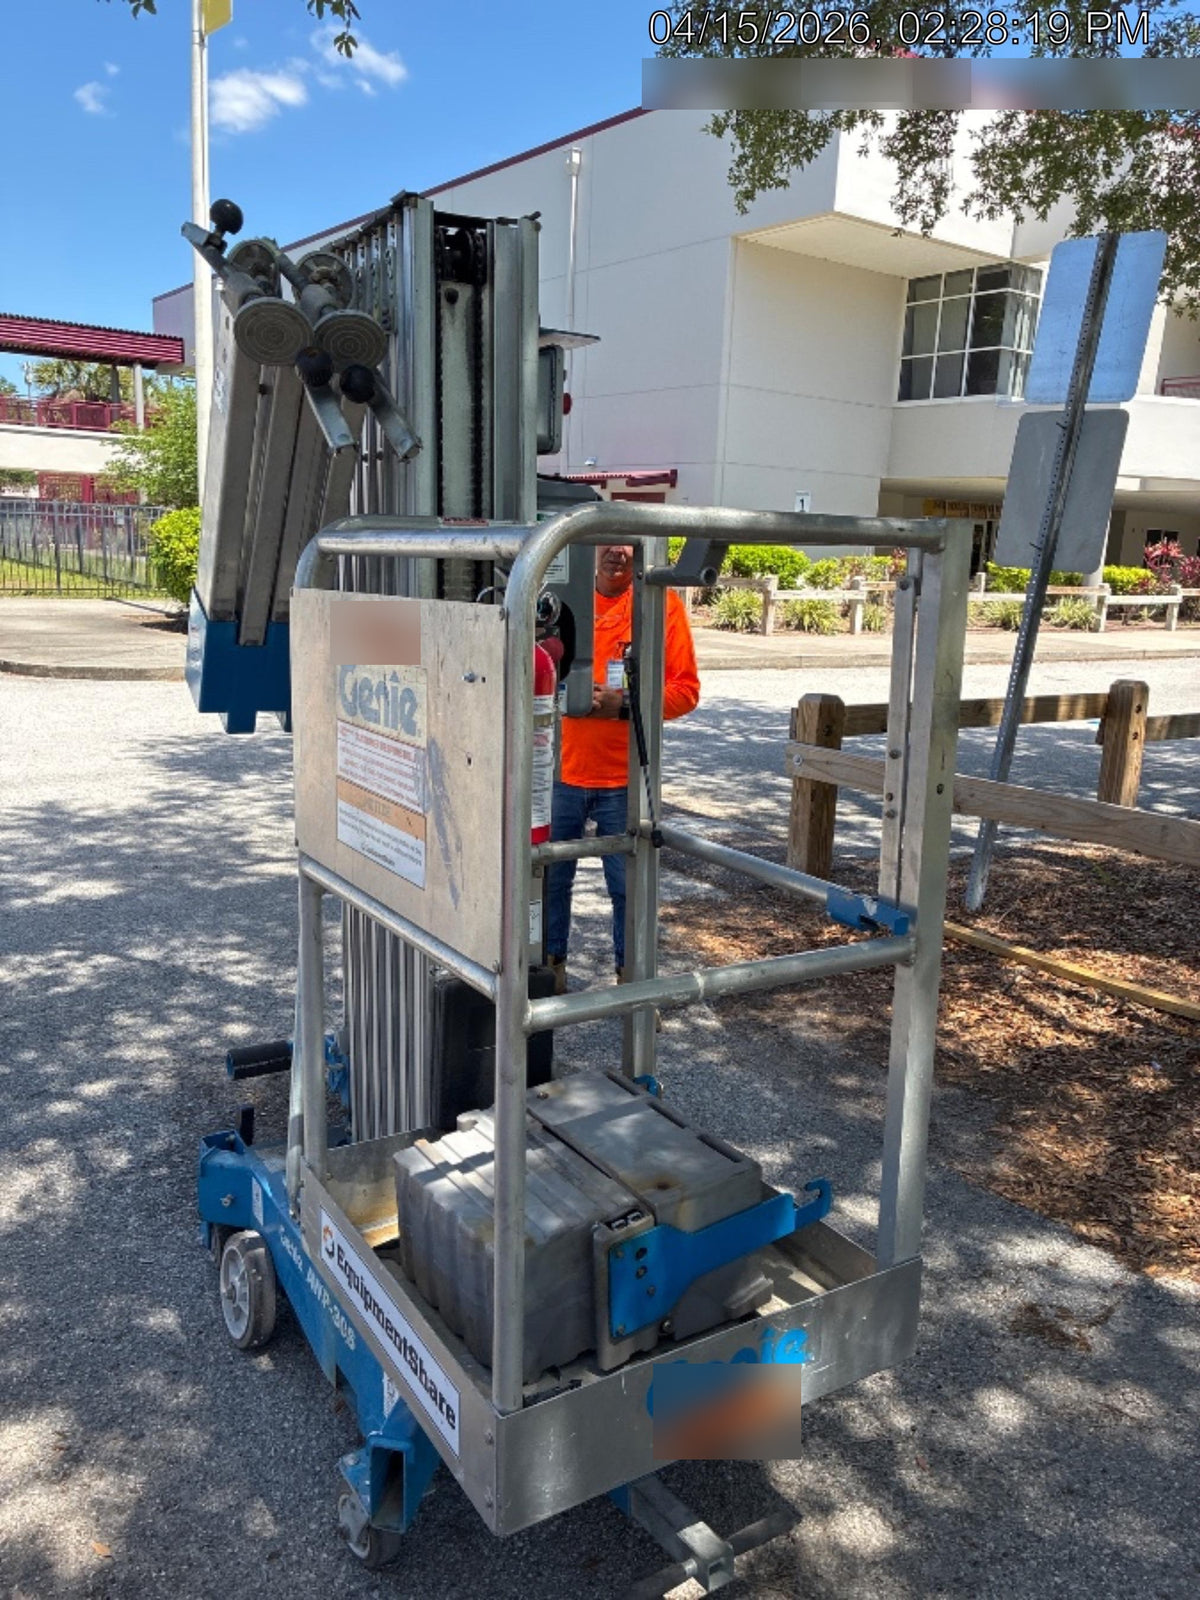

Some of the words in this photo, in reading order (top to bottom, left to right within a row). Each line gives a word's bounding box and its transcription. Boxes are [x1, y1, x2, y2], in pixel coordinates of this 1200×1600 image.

[800, 497, 806, 512] 1
[339, 664, 420, 737] Genie
[336, 1243, 457, 1431] EquipmentShare
